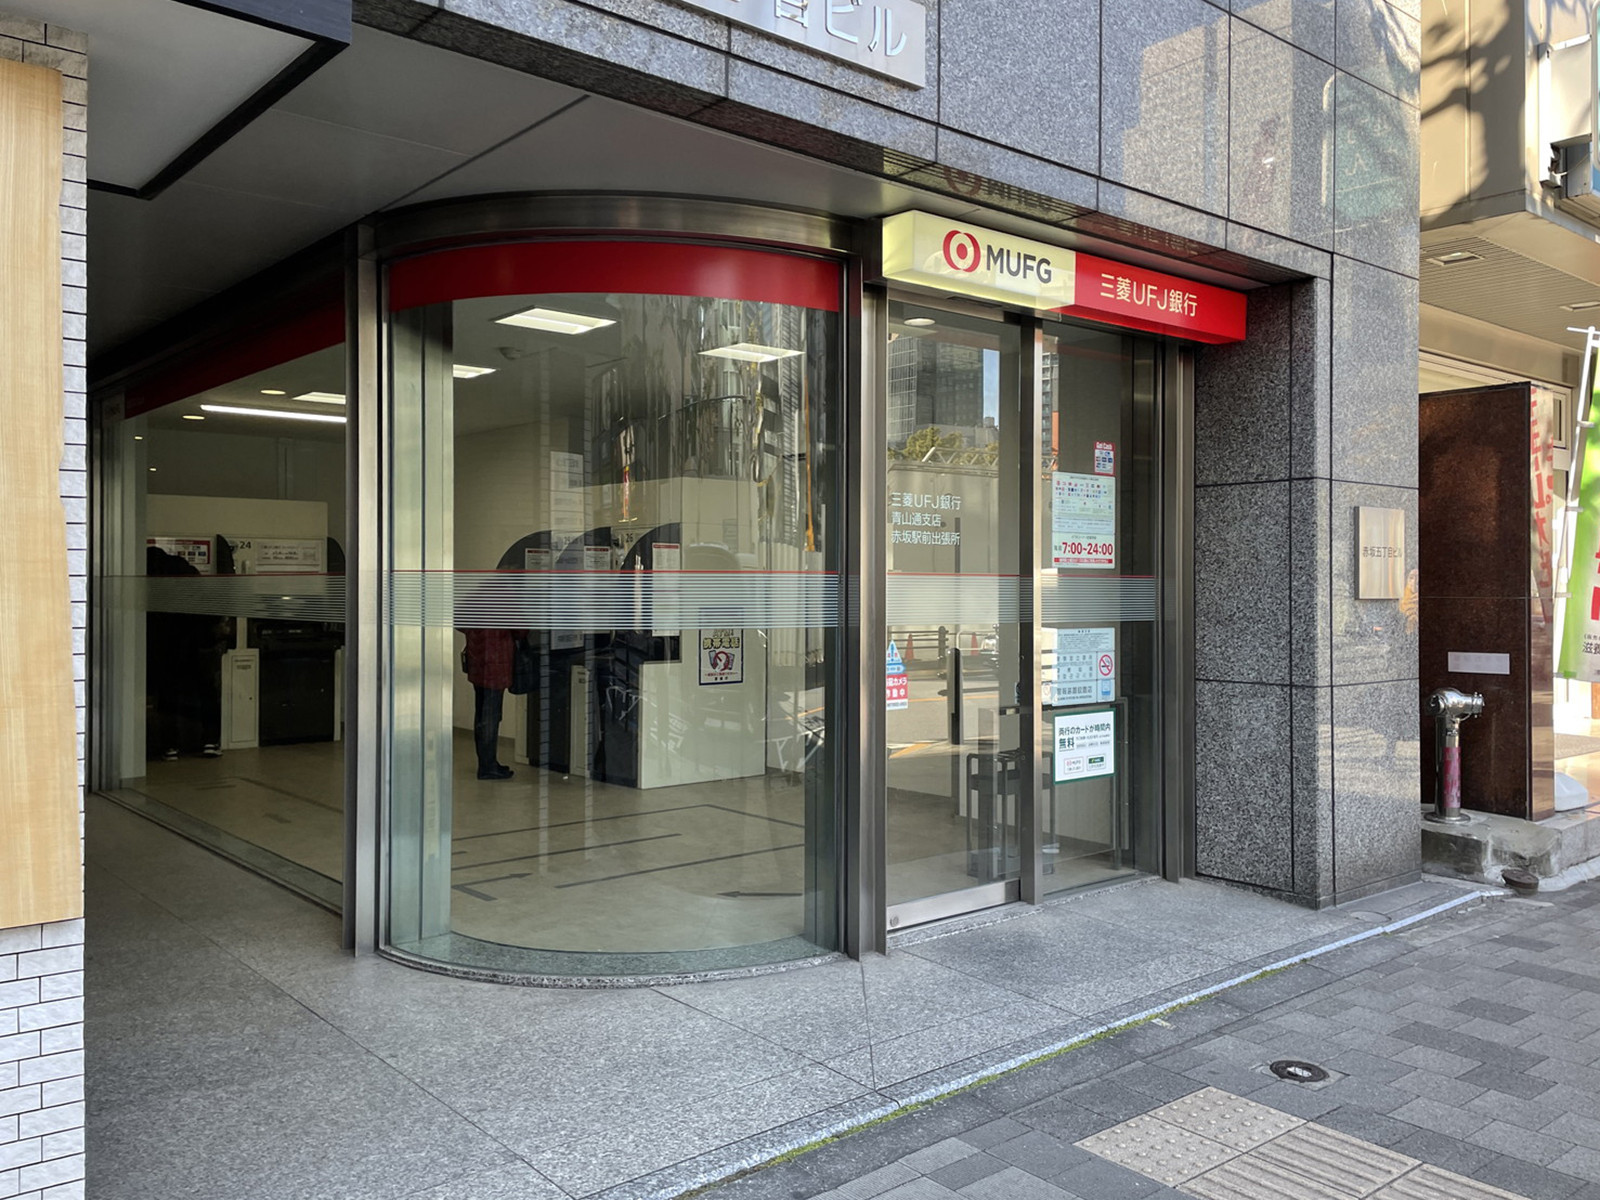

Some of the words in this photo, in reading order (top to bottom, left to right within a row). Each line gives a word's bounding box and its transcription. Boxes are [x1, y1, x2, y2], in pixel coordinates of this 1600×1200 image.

[986, 245, 1052, 284] MUFG
[1100, 272, 1198, 317] 三菱UFJ銀行
[891, 492, 961, 510] 三菱UFJ銀行
[891, 511, 942, 527] 青山通支店
[240, 541, 252, 549] 24
[891, 529, 961, 546] 赤坂駅前出張所
[1059, 737, 1075, 749] 無料
